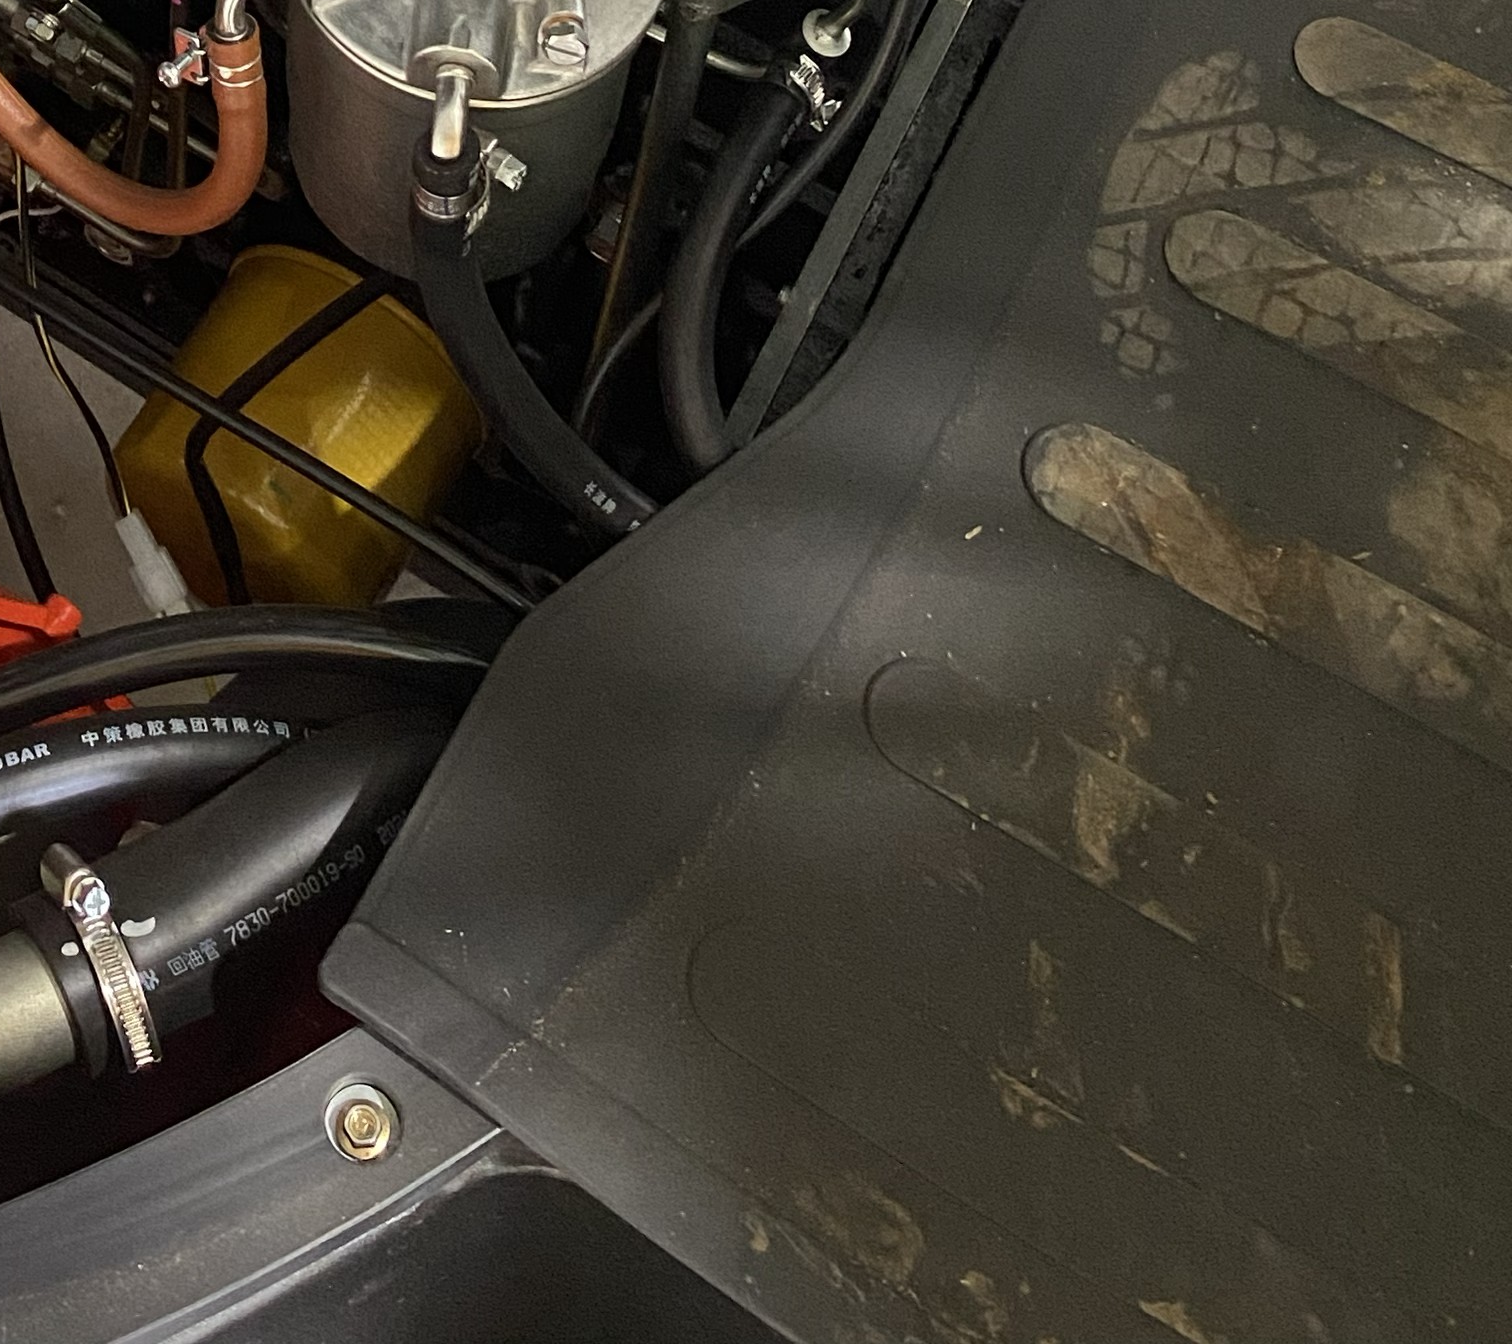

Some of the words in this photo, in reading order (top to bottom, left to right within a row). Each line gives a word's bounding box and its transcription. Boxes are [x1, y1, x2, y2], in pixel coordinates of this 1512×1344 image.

[80, 716, 290, 748] 中策橡胶集团有限公司
[167, 938, 220, 976] 回油管
